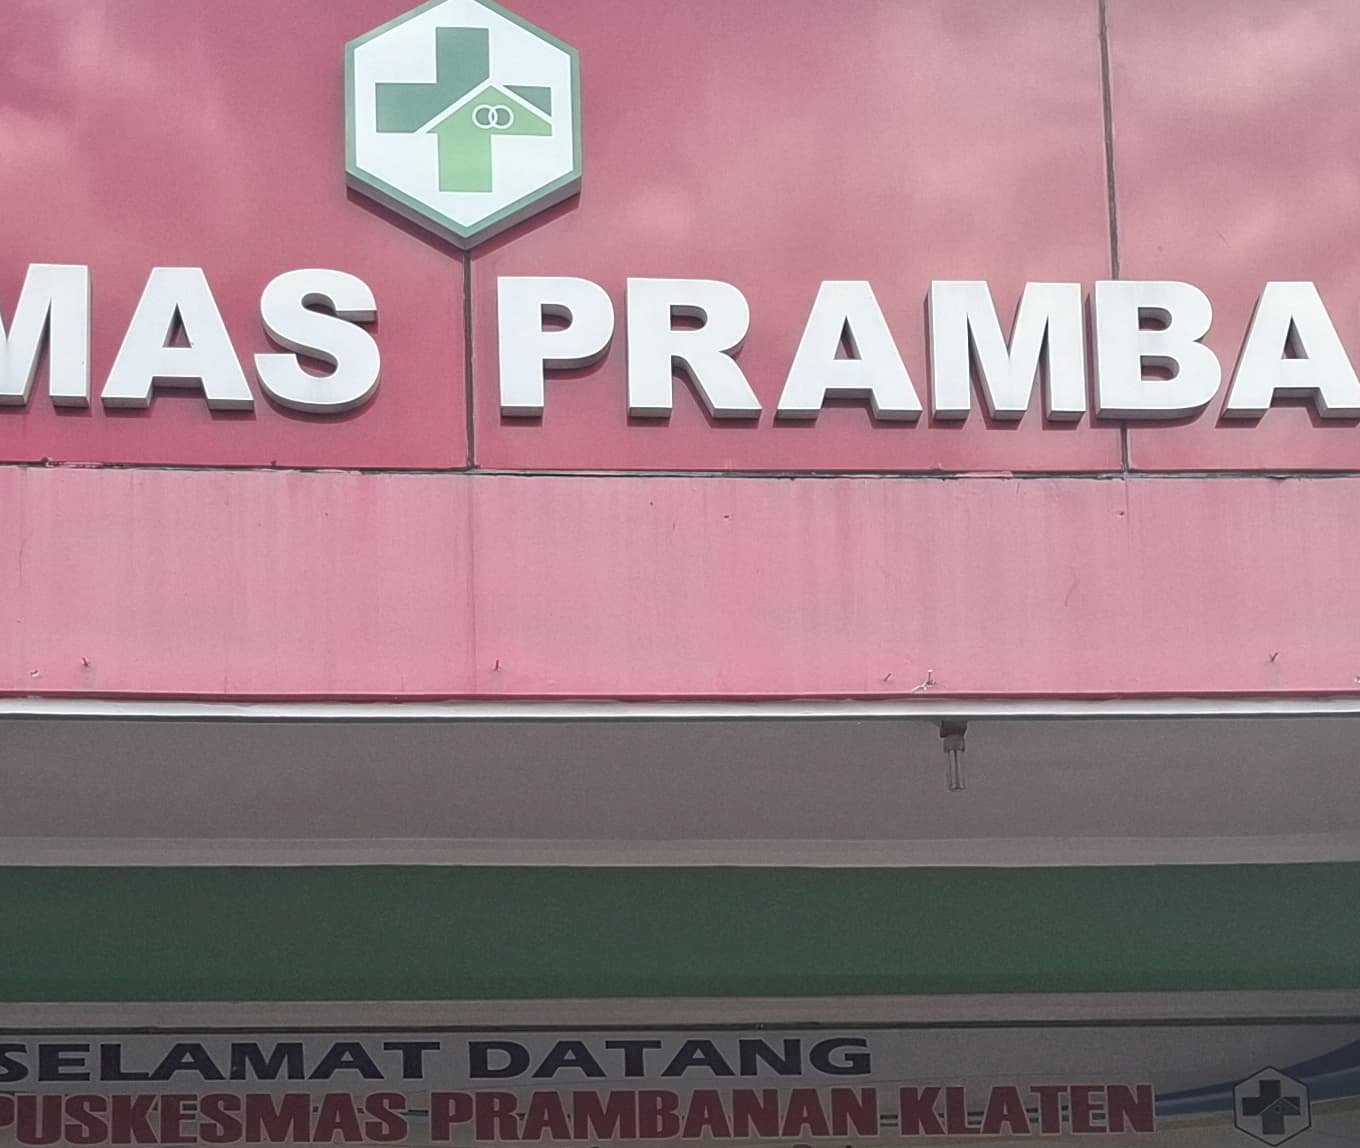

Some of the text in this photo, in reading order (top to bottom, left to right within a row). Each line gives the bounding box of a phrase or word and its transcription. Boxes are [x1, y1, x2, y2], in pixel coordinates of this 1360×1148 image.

[468, 1036, 872, 1079] DATANG
[429, 1084, 878, 1144] PRAMBANAN
[898, 1081, 1156, 1138] KLATEN
